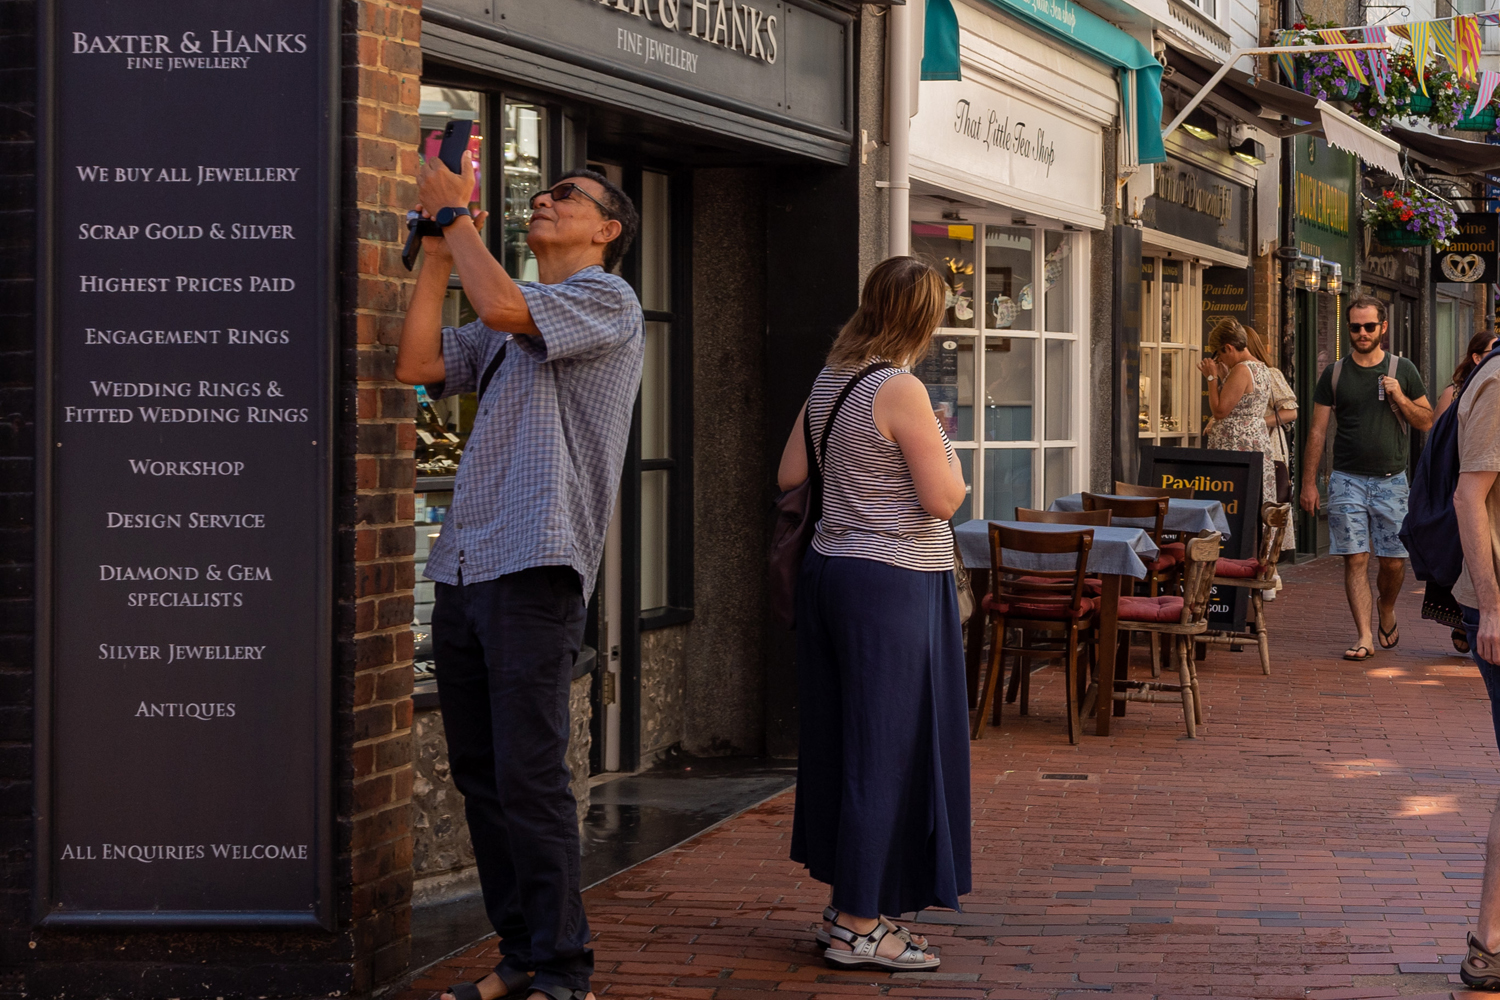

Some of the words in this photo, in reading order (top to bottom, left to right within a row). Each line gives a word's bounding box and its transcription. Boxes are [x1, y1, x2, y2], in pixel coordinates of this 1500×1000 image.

[1061, 5, 1077, 32] shop
[73, 32, 174, 55] BAXTER
[180, 32, 202, 54] &
[210, 30, 308, 54] HANKS
[616, 28, 643, 57] FINE
[644, 36, 699, 75] JEWELLERY
[126, 56, 164, 70] FINE
[167, 56, 251, 72] JEWELLERY
[953, 98, 983, 140] That
[984, 107, 1012, 151] Little
[1011, 122, 1032, 155] Tea
[1031, 128, 1056, 179] Shop
[76, 165, 109, 182] WE
[114, 166, 153, 182] BUY
[156, 167, 192, 182] ALL
[196, 165, 301, 186] JEWELLERY
[78, 223, 140, 241] SCRAP
[145, 223, 204, 240] GOLD
[210, 224, 227, 240] &
[230, 223, 297, 240] SILVER
[1455, 222, 1487, 235] ivine
[1441, 239, 1495, 253] iamond
[79, 275, 170, 293] HIGHEST
[176, 276, 243, 292] PRICES
[249, 275, 296, 292] PAID
[1202, 284, 1245, 296] Pavilion
[1202, 300, 1249, 312] Diamond
[85, 328, 222, 345] ENGAGEMENT
[227, 328, 290, 345] RINGS
[90, 381, 192, 398] WEDDING
[198, 381, 261, 398] RINGS
[266, 382, 283, 397] &
[65, 406, 134, 423] FITTED
[139, 407, 241, 423] WEDDING
[246, 406, 309, 423] RINGS
[129, 459, 245, 477] WORKSHOP
[1162, 474, 1235, 493] Pavilion
[106, 512, 182, 529] DESIGN
[188, 512, 266, 529] SERVICE
[99, 564, 200, 582] DIAMOND
[205, 565, 223, 581] &
[227, 564, 272, 581] GEM
[127, 592, 243, 608] SPECIALISTS
[98, 644, 162, 660] SILVER
[168, 644, 267, 664] JEWELLERY
[134, 702, 236, 721] ANTIQUES
[60, 843, 97, 861] ALL
[101, 844, 205, 864] ENQUIRIES
[210, 844, 308, 861] WELCOME
